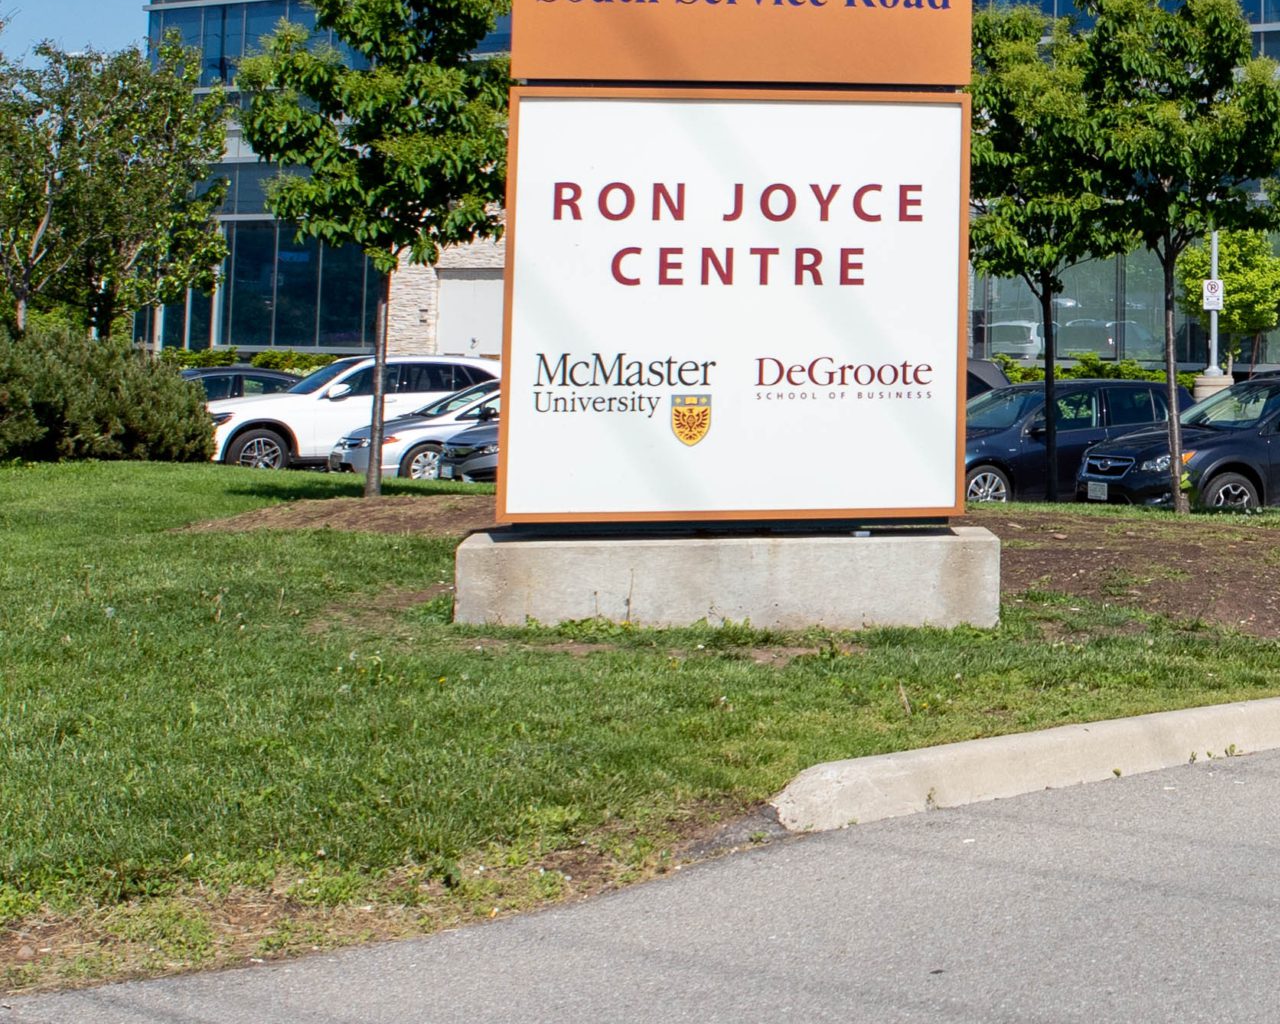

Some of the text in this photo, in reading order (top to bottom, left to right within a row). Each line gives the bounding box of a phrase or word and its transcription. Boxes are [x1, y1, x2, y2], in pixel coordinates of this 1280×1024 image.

[552, 182, 924, 222] RON JOYCE
[611, 247, 865, 286] CENTRE
[533, 353, 716, 387] McMaster
[755, 357, 933, 386] DeGroote
[533, 391, 661, 417] University
[757, 391, 932, 400] SCHOOL OF BUSINESS
